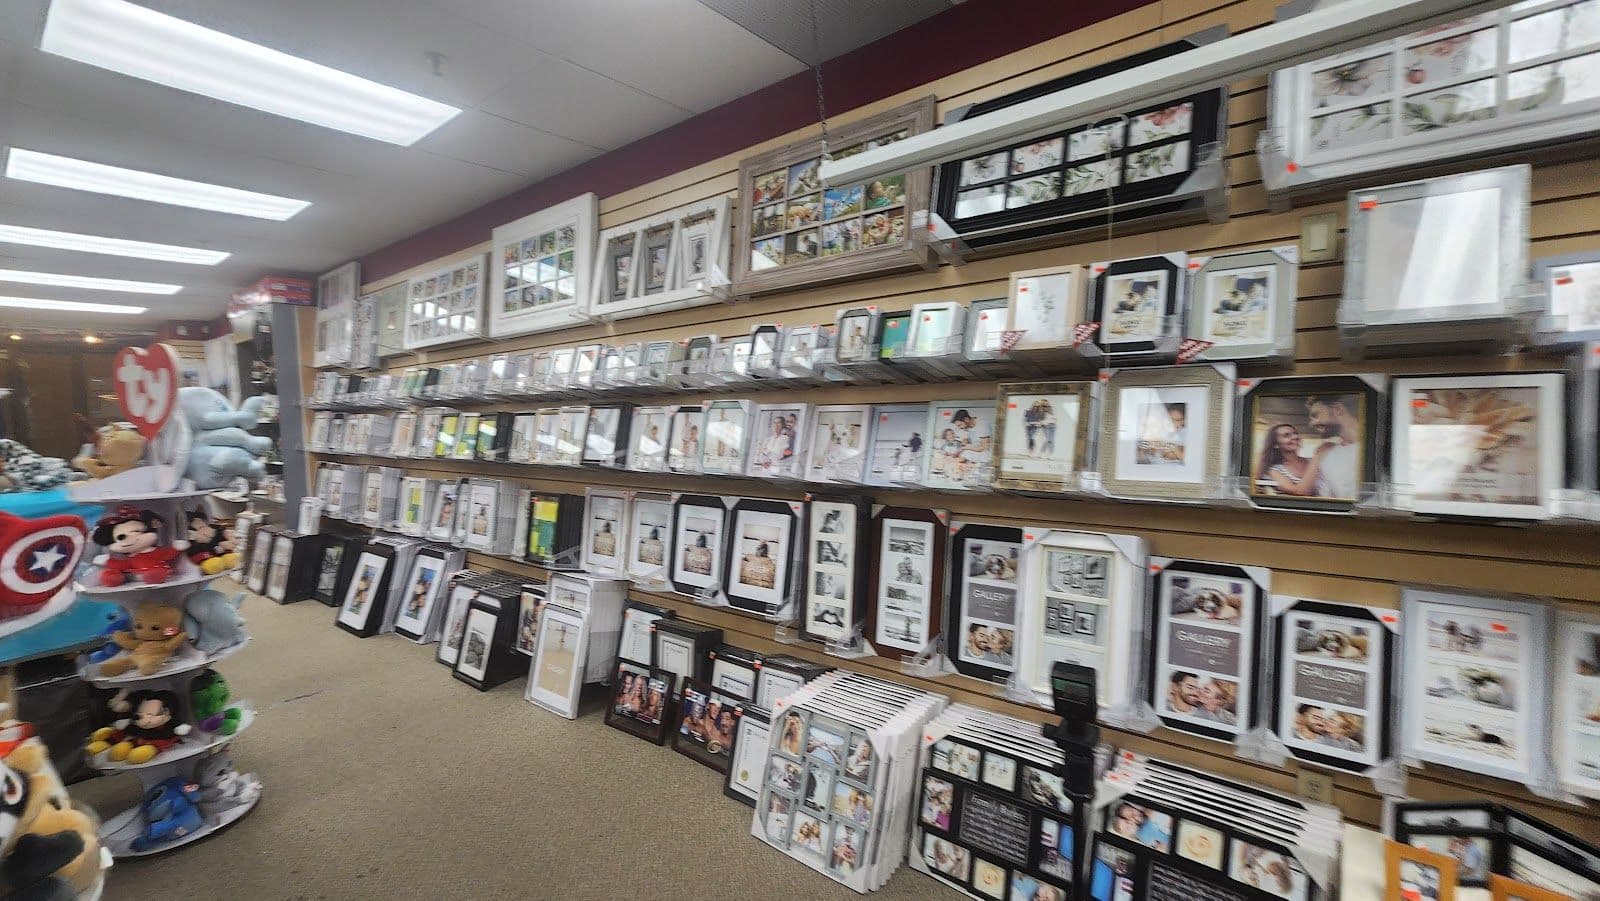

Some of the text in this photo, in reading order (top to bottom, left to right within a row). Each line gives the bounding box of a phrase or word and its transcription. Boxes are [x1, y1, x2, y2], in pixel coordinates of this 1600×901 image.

[117, 354, 170, 424] ty
[973, 589, 1010, 602] GALLERY
[1175, 630, 1233, 649] GALLERY
